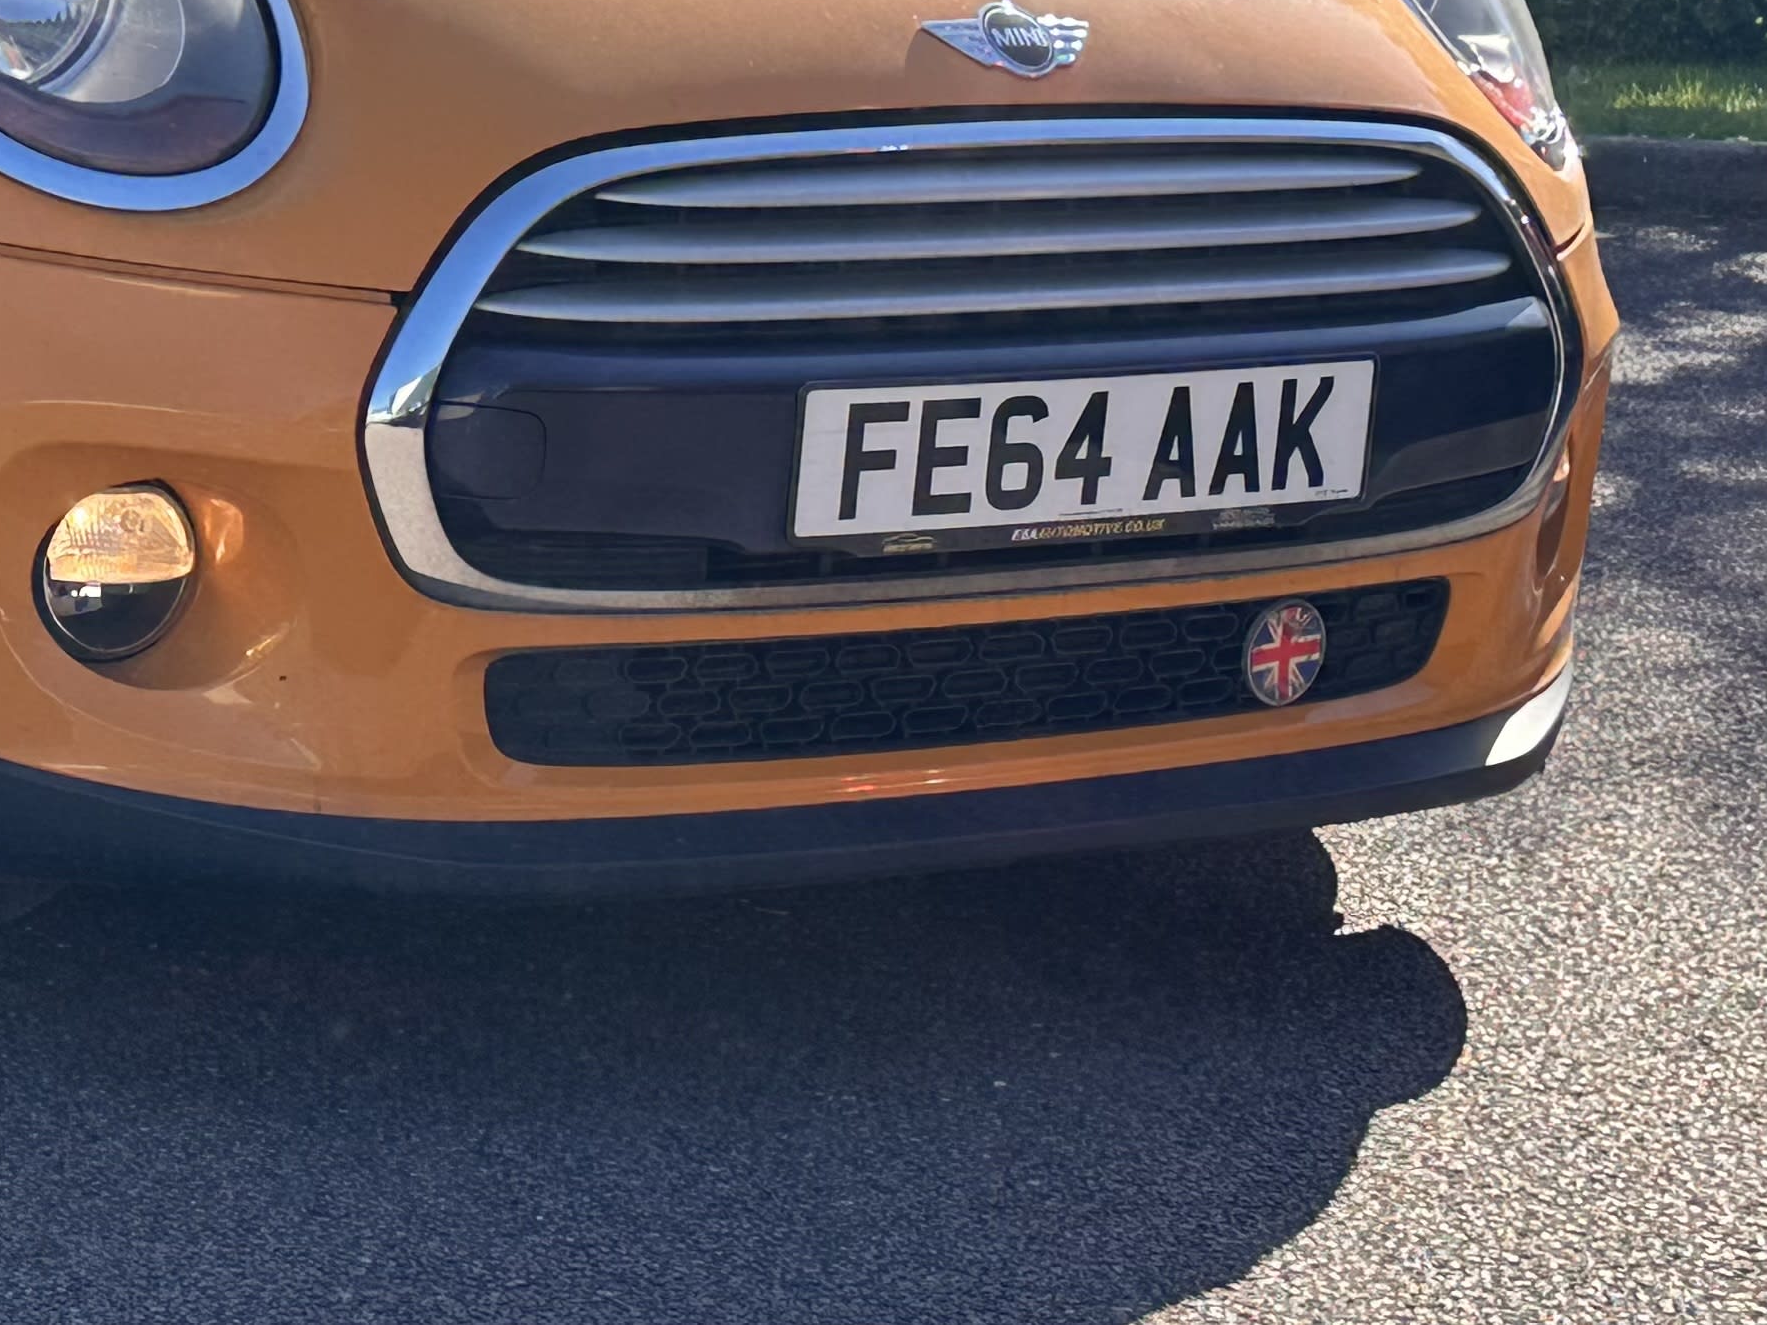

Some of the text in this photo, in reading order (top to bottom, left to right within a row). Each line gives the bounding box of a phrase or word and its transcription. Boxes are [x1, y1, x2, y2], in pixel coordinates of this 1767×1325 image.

[990, 27, 1049, 47] MINI
[837, 376, 1335, 521] FE64 AAK
